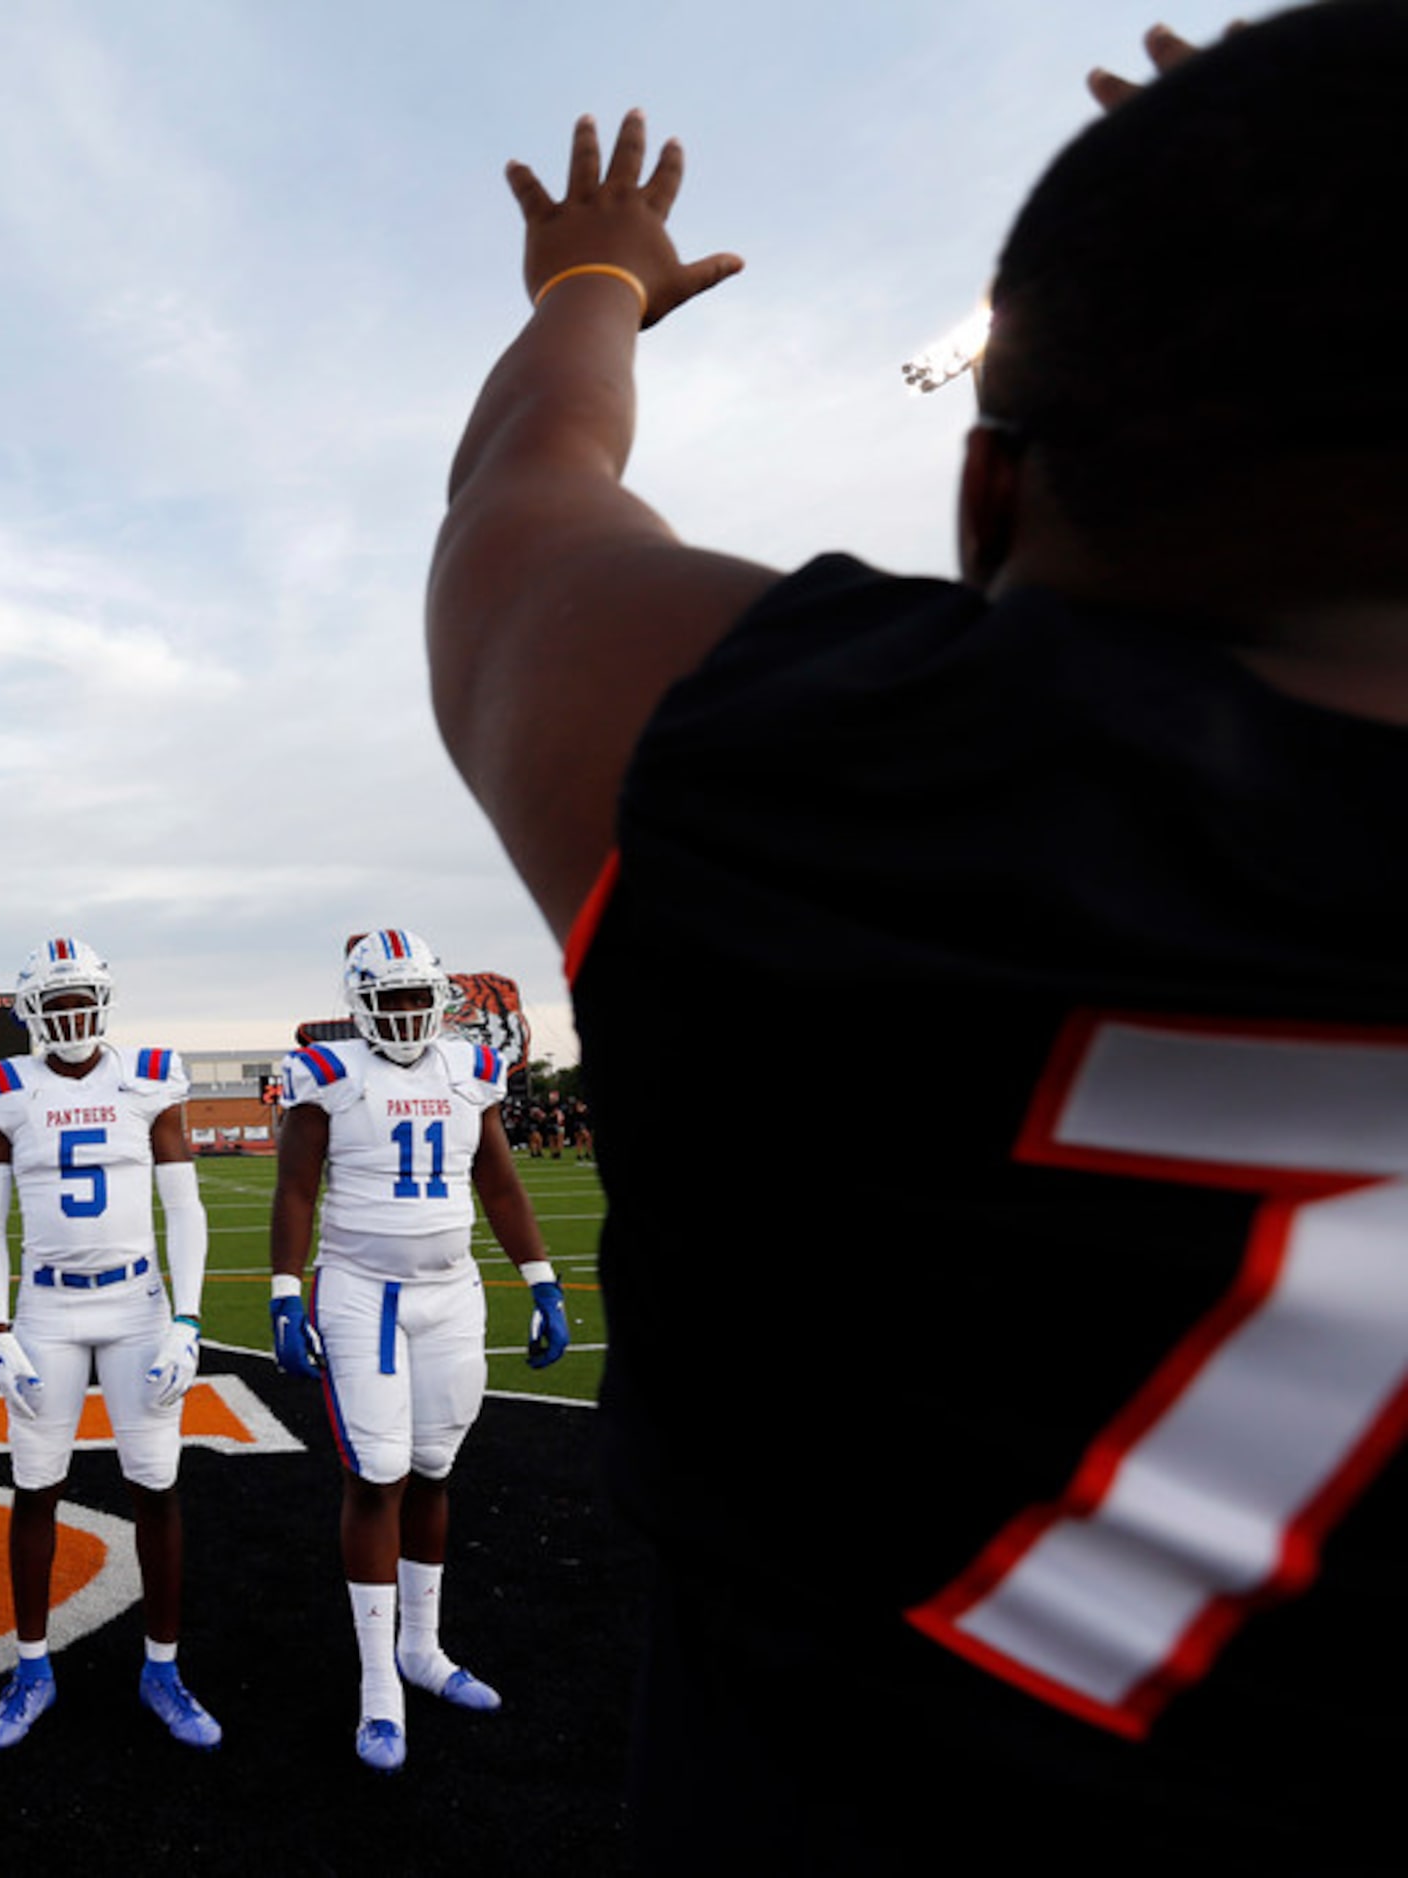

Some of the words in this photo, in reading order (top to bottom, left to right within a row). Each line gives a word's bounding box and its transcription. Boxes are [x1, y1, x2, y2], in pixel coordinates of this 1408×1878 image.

[46, 1105, 117, 1127] PANTHERS
[387, 1098, 452, 1116] PANTHERS
[59, 1128, 108, 1218] 5
[390, 1120, 449, 1199] 11
[903, 1005, 1408, 1740] 7
